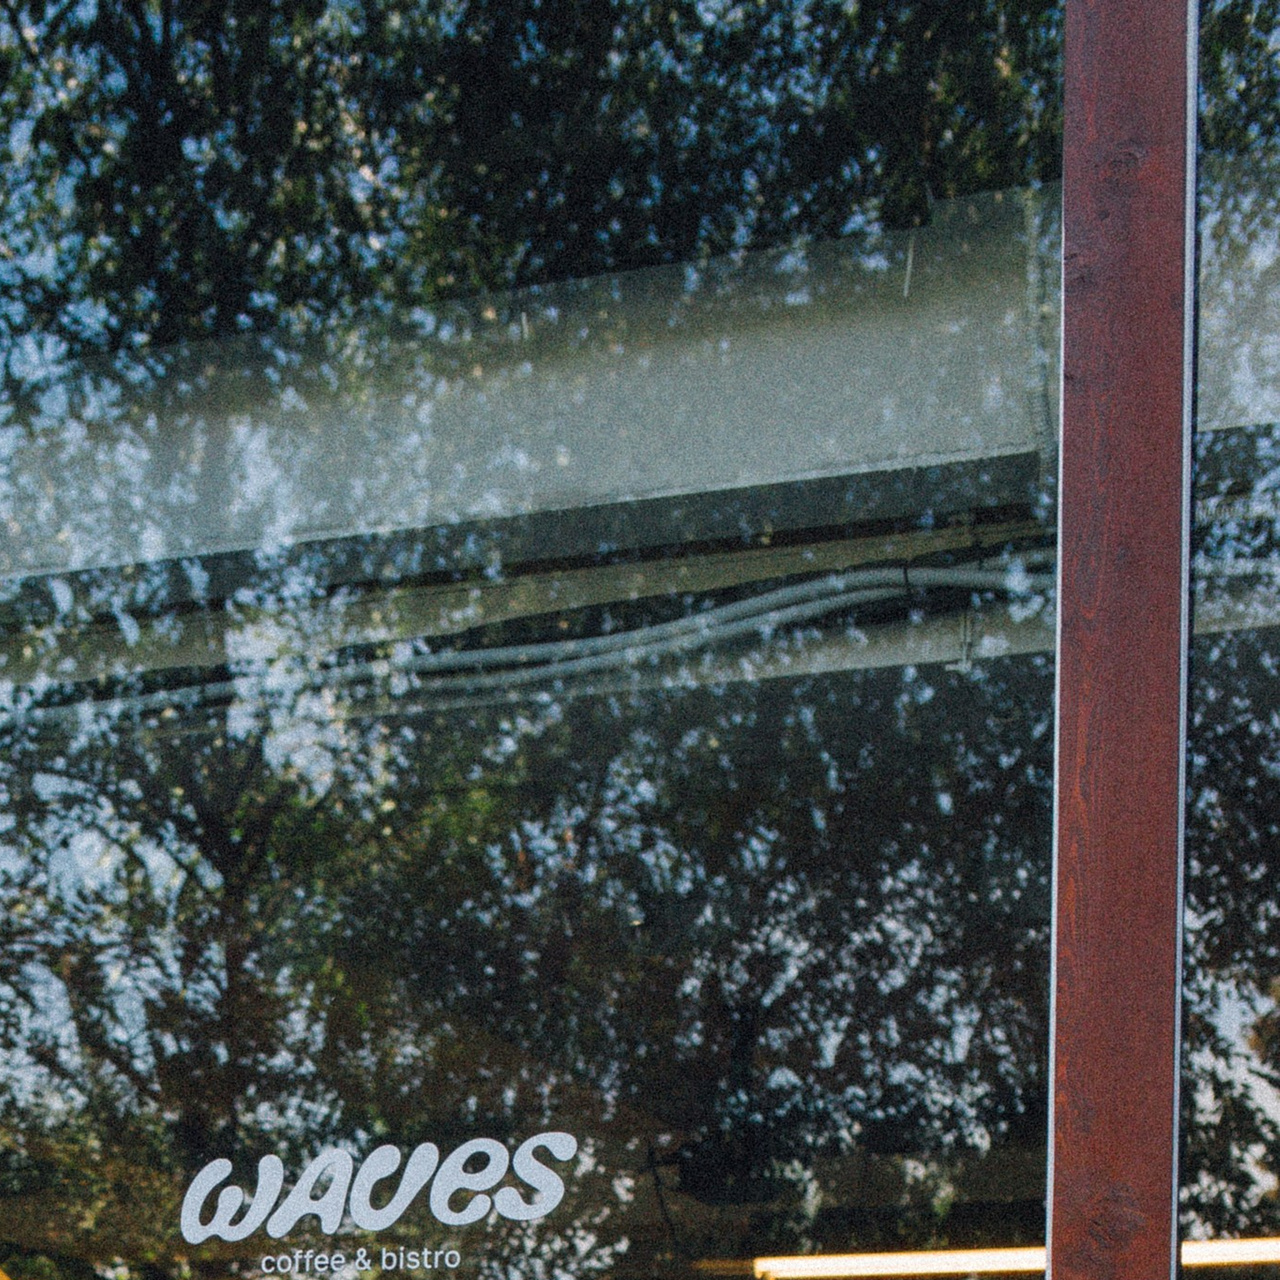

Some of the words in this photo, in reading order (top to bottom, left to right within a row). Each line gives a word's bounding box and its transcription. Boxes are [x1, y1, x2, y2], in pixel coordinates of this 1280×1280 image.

[261, 1248, 345, 1274] coffee
[356, 1248, 373, 1271] &
[381, 1246, 461, 1270] bistro
